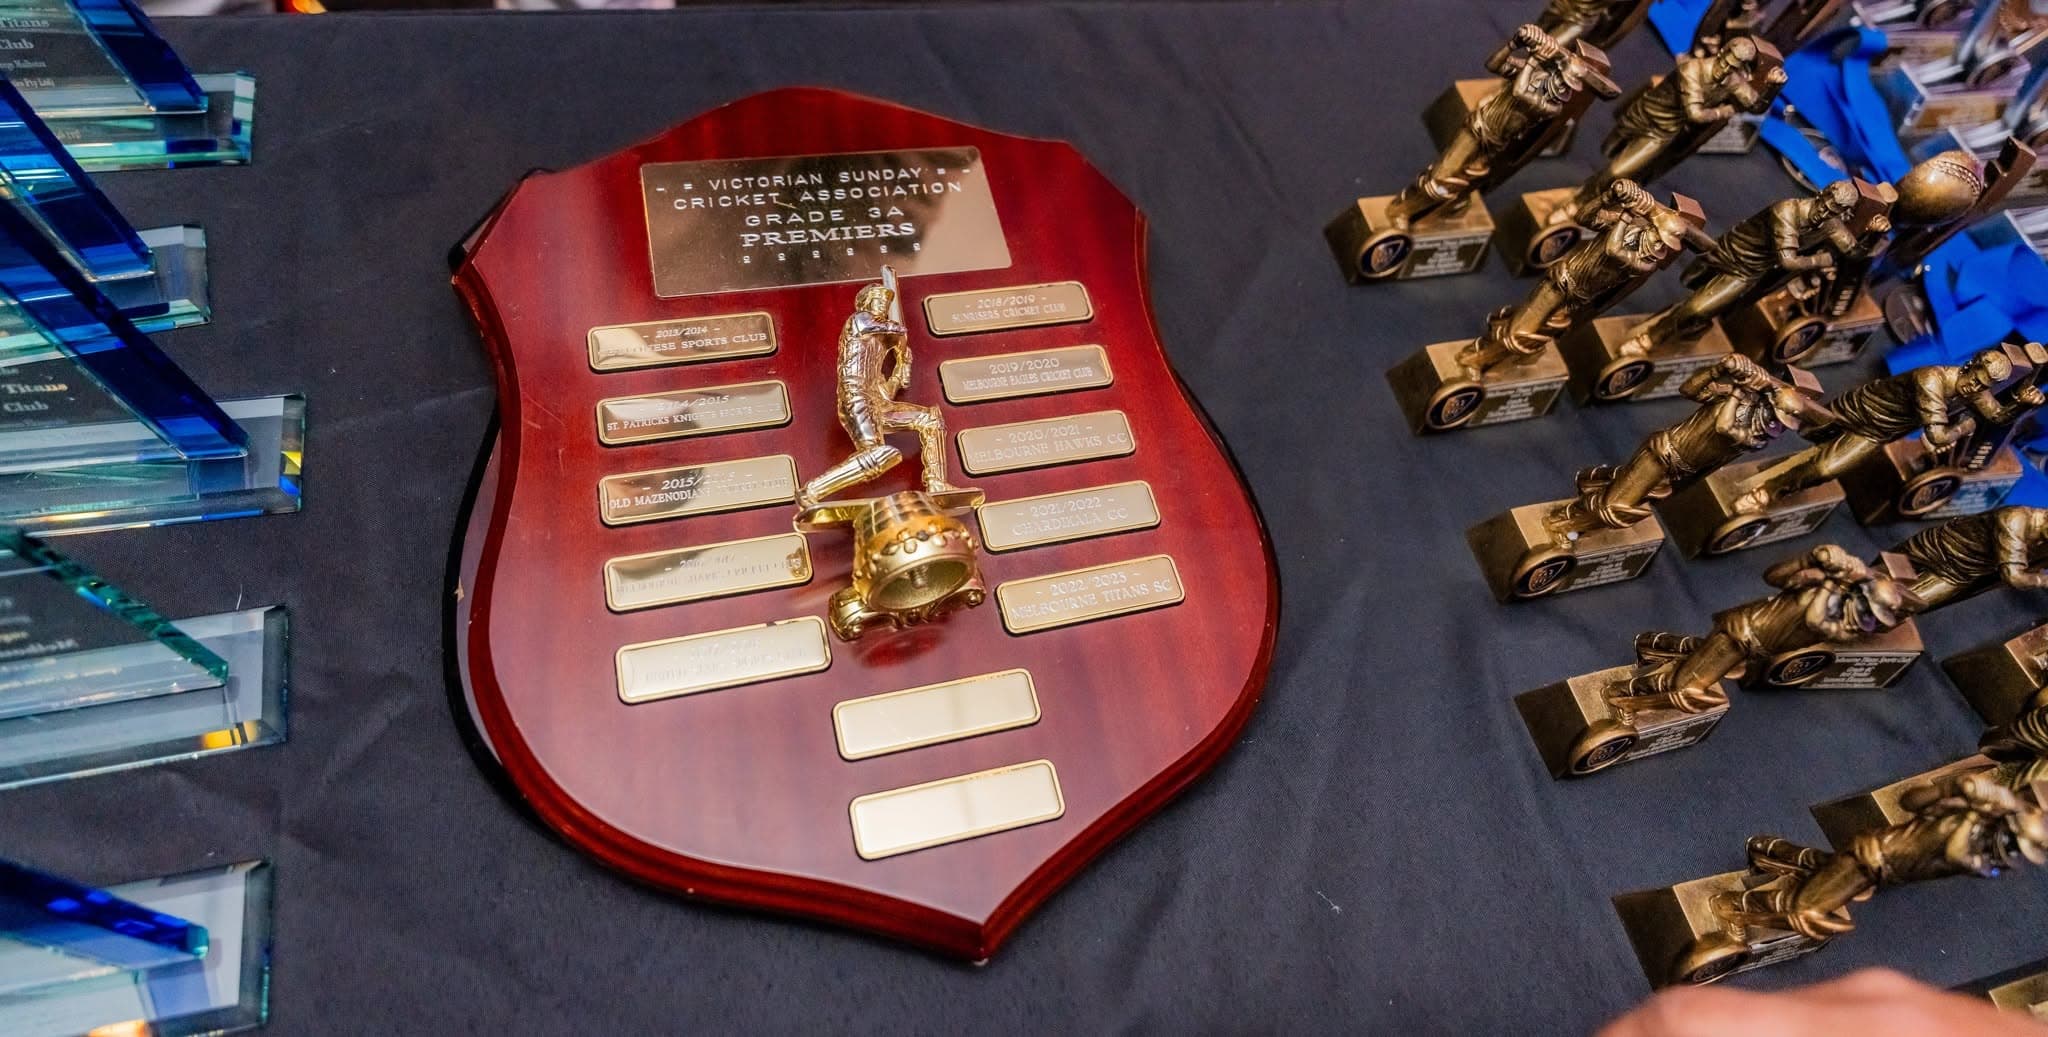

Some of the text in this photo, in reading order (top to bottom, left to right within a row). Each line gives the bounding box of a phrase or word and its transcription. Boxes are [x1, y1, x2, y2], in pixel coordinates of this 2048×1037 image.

[709, 167, 922, 191] VICTORIAN SUNDAY
[674, 182, 962, 210] CRICKET ASSOCIATION
[745, 206, 904, 226] GRADE 3A
[740, 222, 916, 247] PREMIERS
[681, 336, 728, 349] SPORTS
[733, 333, 767, 344] CLUB
[989, 358, 1060, 375] 2019/2020
[1, 384, 68, 394] Titans
[3, 401, 48, 412] Club
[624, 416, 670, 429] PATRICKS
[673, 410, 715, 424] KNIG
[1009, 426, 1081, 444] 2020/2021
[969, 432, 1127, 464] MELBOURNE HAWKS CC
[609, 498, 631, 509] OLD
[1011, 592, 1098, 619] MELBOURNE
[1104, 583, 1149, 603] TITANS
